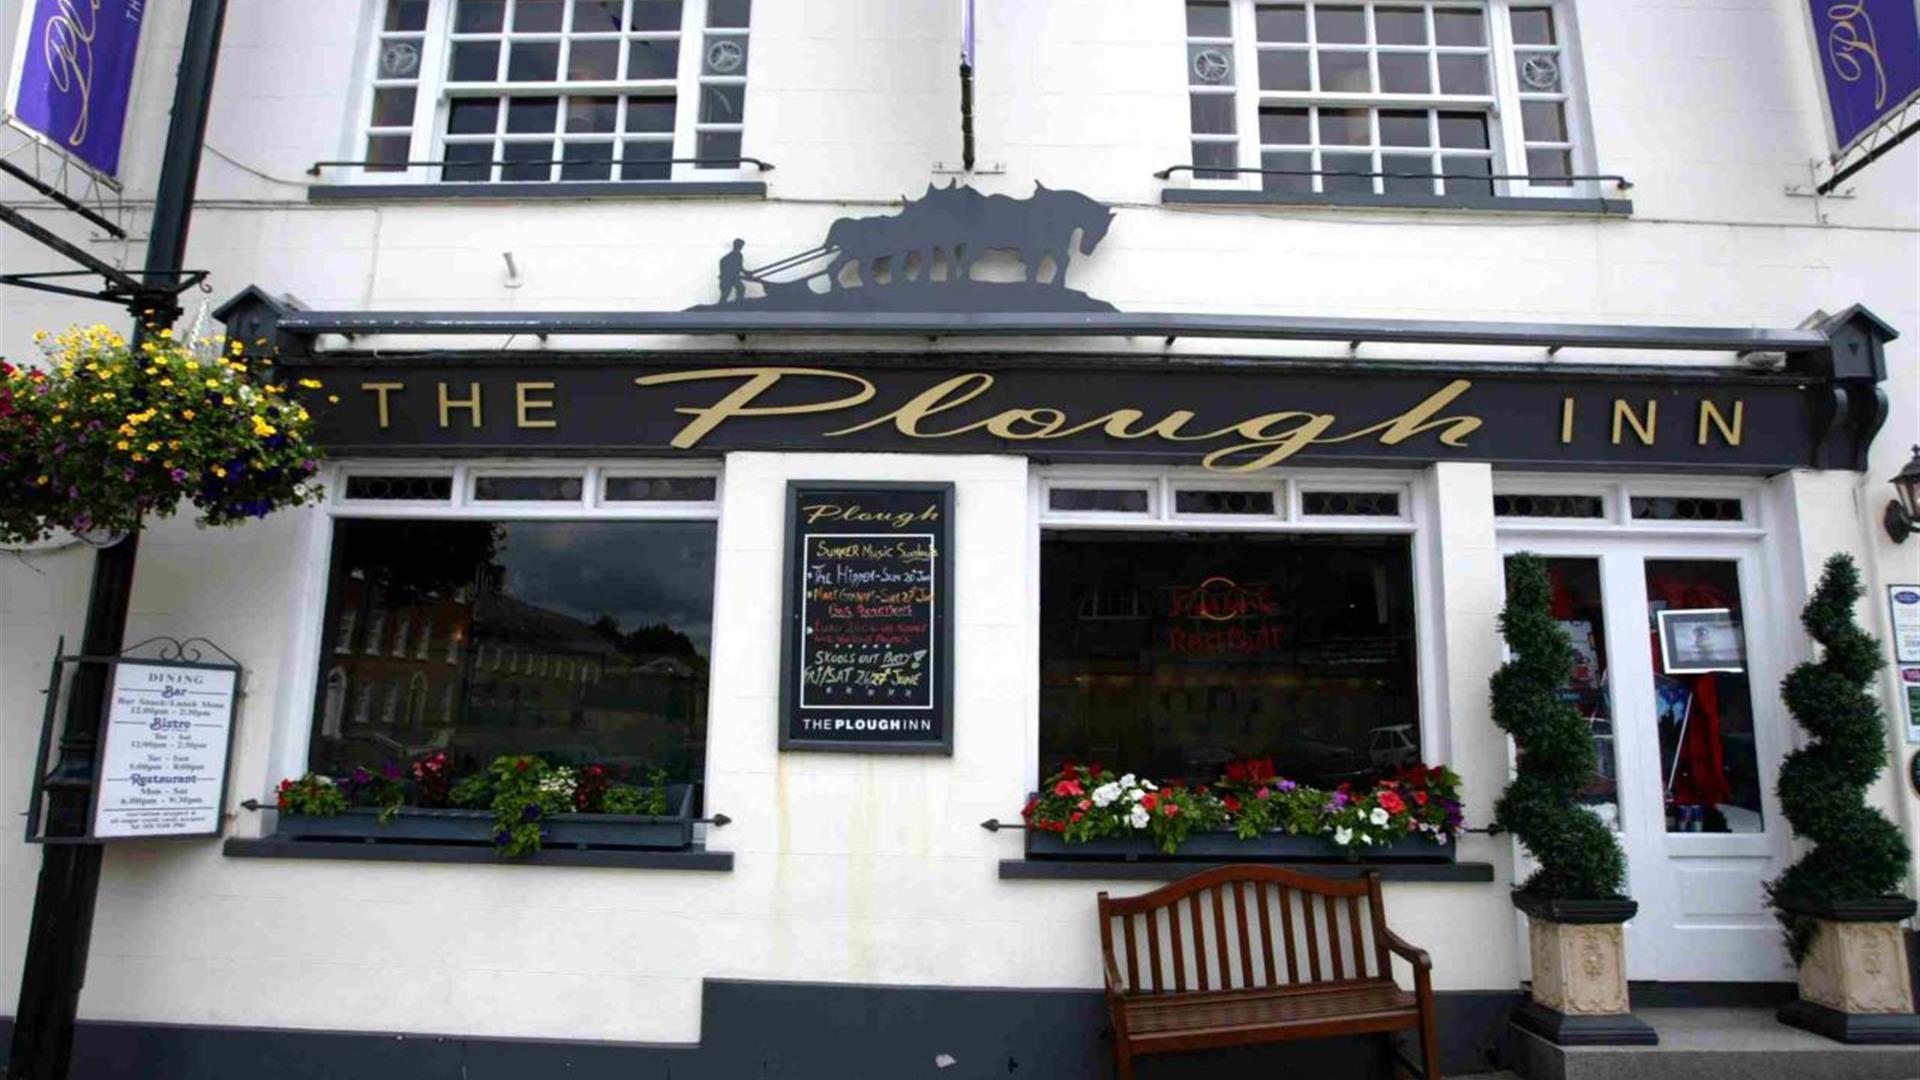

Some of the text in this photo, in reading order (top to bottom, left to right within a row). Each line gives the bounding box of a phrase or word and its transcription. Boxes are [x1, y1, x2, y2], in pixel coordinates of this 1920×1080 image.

[361, 366, 1744, 473] THE Plough INN
[801, 503, 939, 529] Plough
[148, 672, 204, 685] DINING
[161, 685, 188, 698] Bar
[149, 717, 191, 731] Bistro
[802, 718, 931, 731] THE PLOUGH INN
[129, 773, 197, 787] Restaurant
